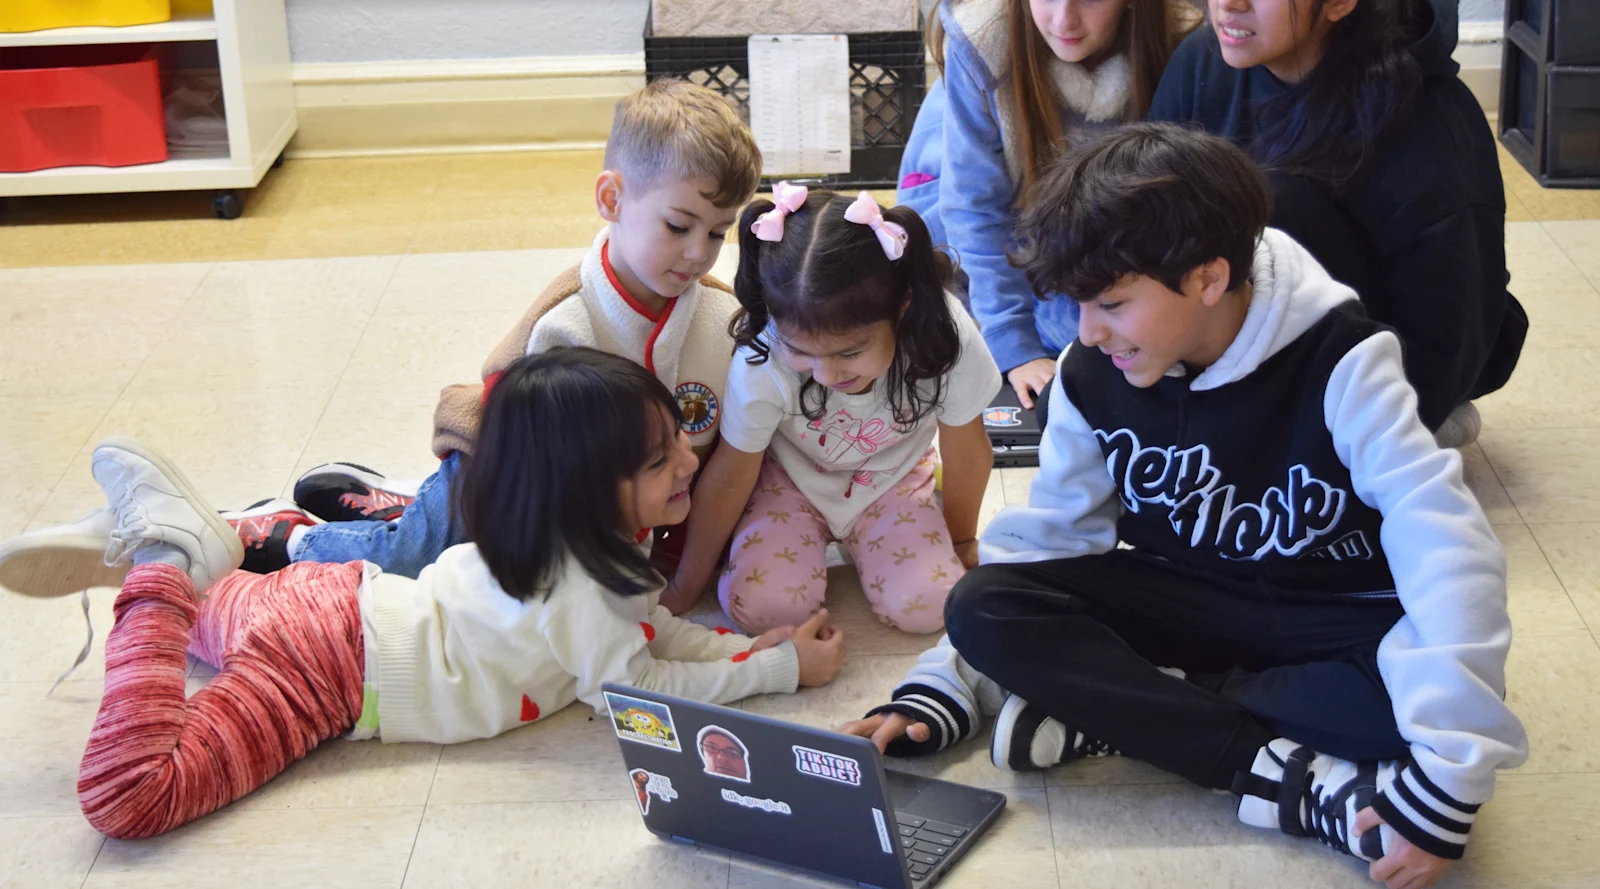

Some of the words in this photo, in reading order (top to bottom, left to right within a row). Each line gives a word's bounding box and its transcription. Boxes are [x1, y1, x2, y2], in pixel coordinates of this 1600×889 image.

[797, 749, 823, 765] TIK
[825, 756, 856, 772] TOK
[801, 760, 857, 783] ADDICT
[745, 797, 779, 811] google
[780, 803, 789, 812] it
